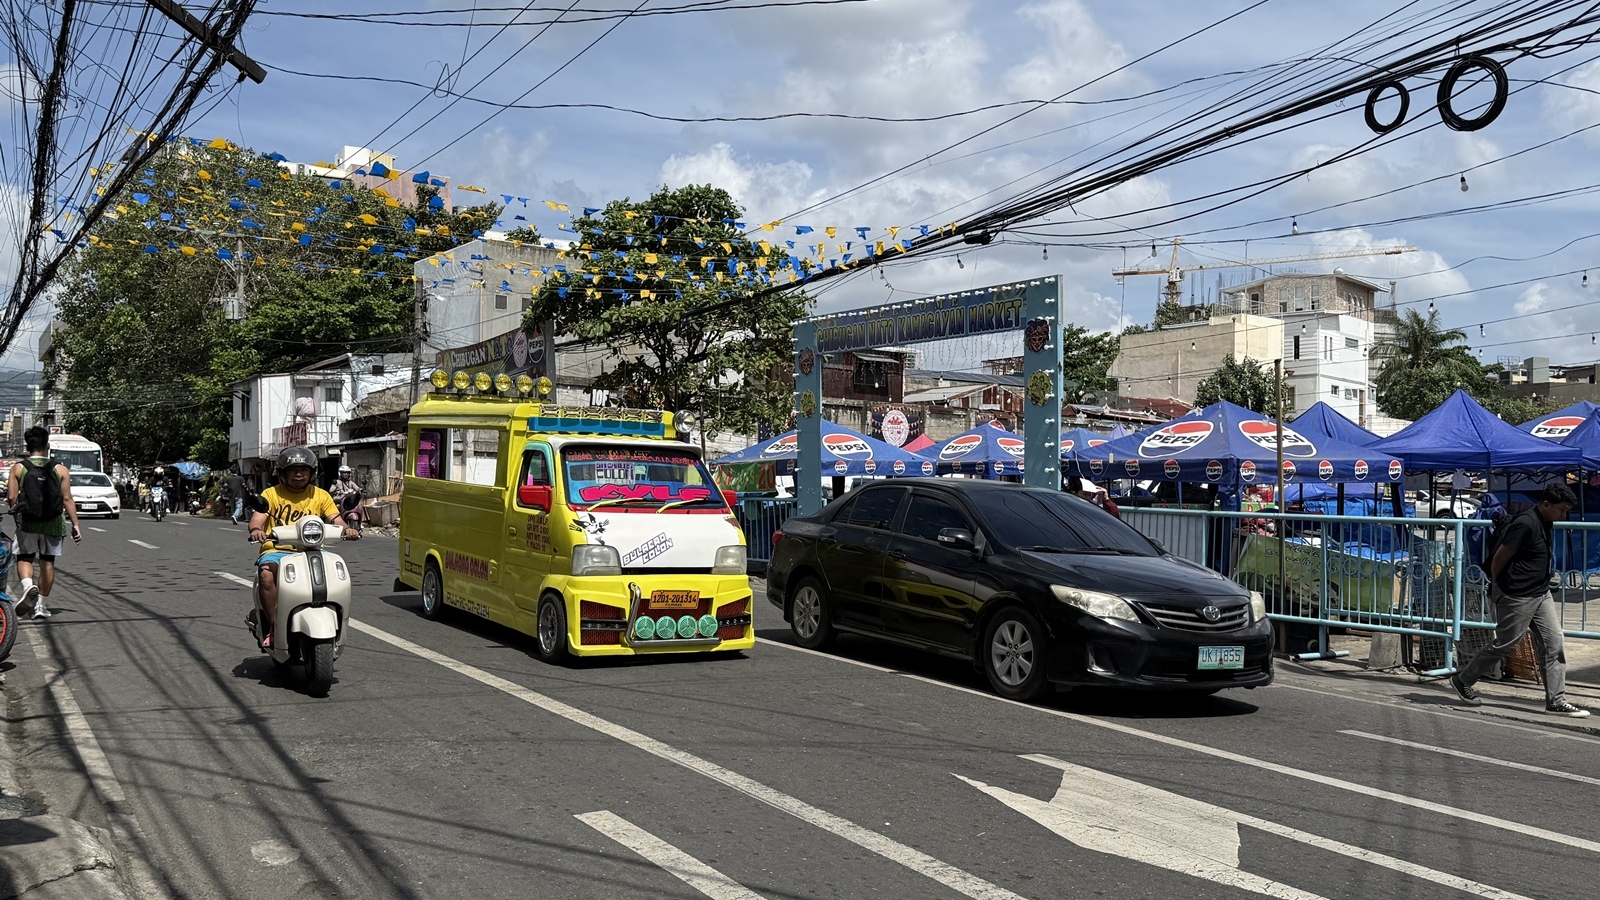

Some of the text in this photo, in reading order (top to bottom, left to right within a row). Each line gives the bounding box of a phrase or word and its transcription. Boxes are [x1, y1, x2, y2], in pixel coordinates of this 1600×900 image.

[817, 299, 1023, 353] CHIBUGAN NATO KAMAGAYAN MARKET
[529, 340, 544, 348] PEPSI
[451, 346, 487, 368] CHIBUGAN
[1148, 434, 1205, 444] PEPSI
[826, 443, 869, 452] PEPSI
[944, 443, 978, 452] PEPSI
[580, 484, 711, 502] KYLE
[642, 538, 673, 564] COLON
[652, 595, 697, 604] 1201-201314
